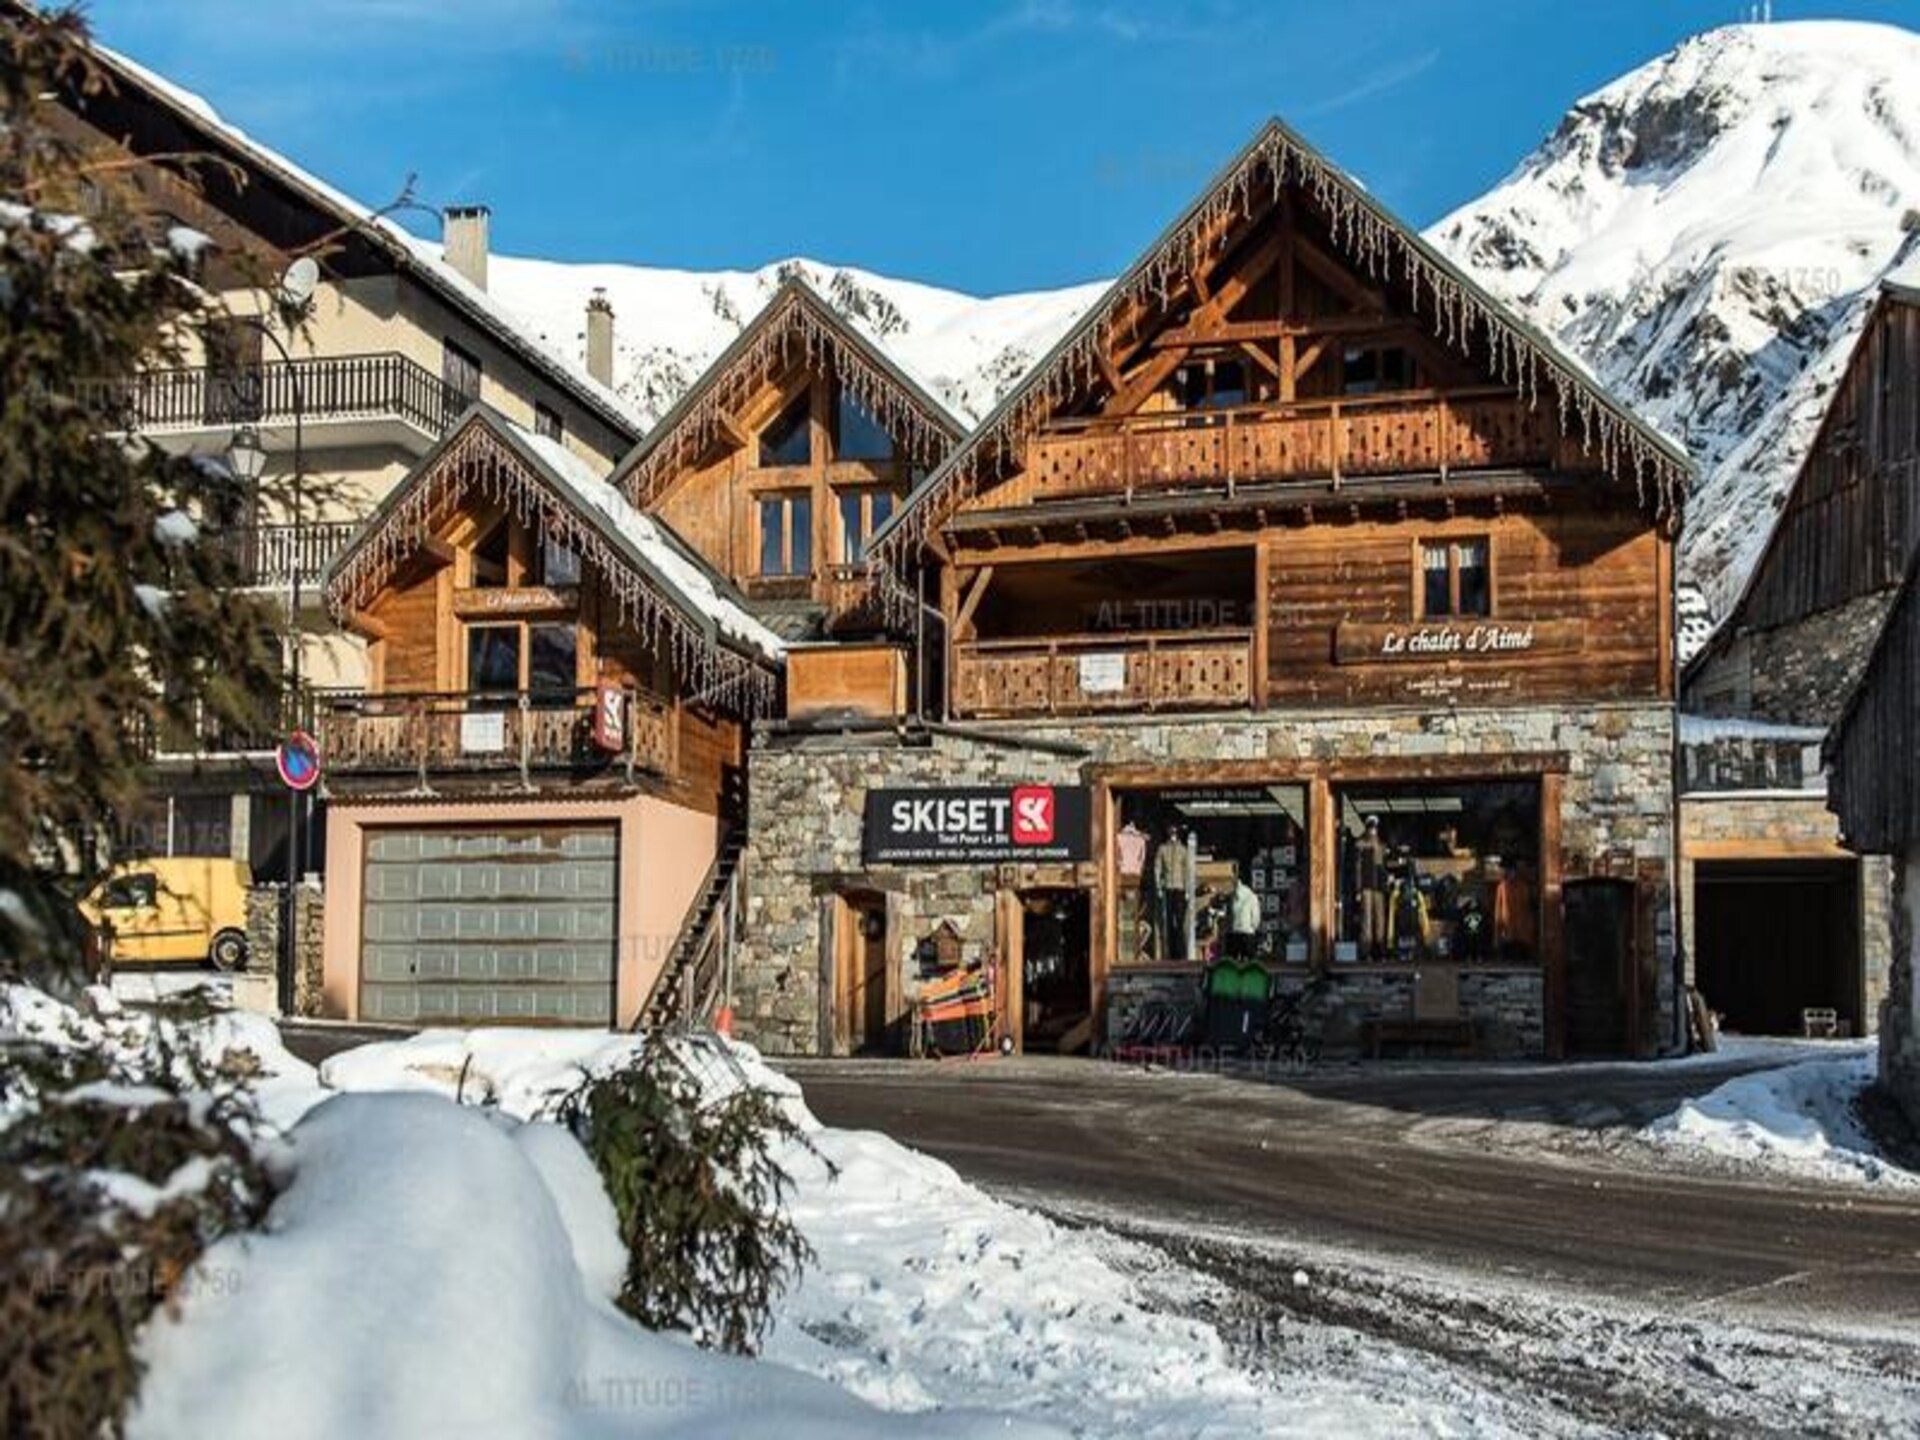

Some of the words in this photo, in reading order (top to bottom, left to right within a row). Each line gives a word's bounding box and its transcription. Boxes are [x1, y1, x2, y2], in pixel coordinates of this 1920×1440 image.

[1382, 632, 1405, 652] Le
[1408, 627, 1461, 652] chalet
[891, 799, 1010, 832] SKISET
